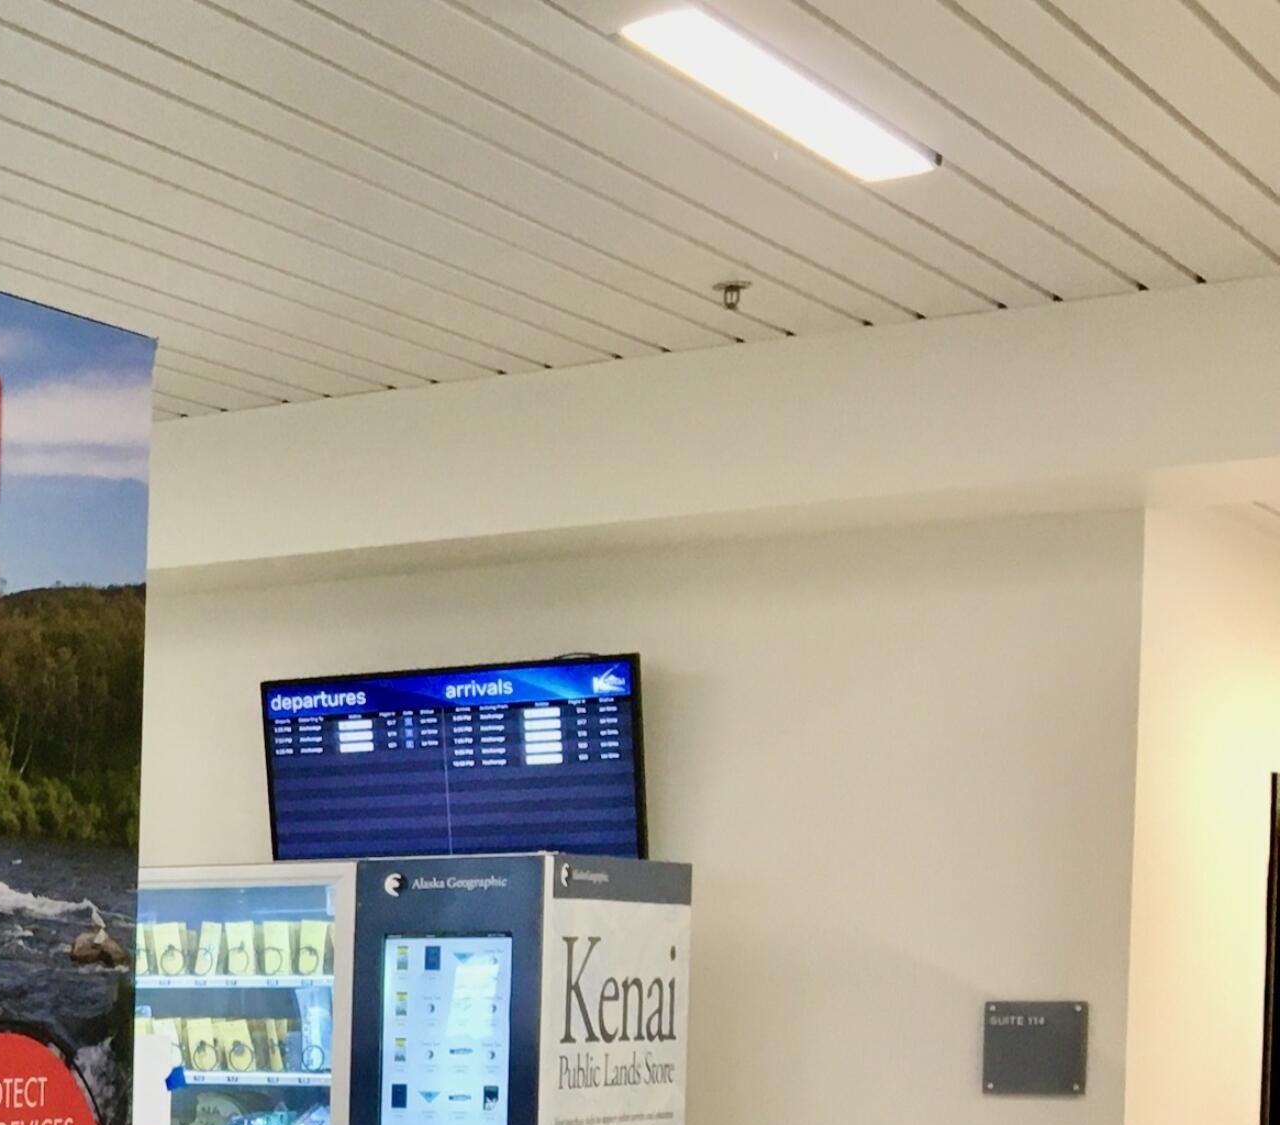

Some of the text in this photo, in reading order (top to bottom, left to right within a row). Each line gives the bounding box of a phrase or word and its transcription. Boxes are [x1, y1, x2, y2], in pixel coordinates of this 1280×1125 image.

[446, 679, 513, 699] arrivals
[271, 691, 366, 713] departures
[411, 875, 508, 891] Alaska Geographic
[560, 937, 676, 1043] Kenai
[558, 1051, 674, 1090] Public Lands Store
